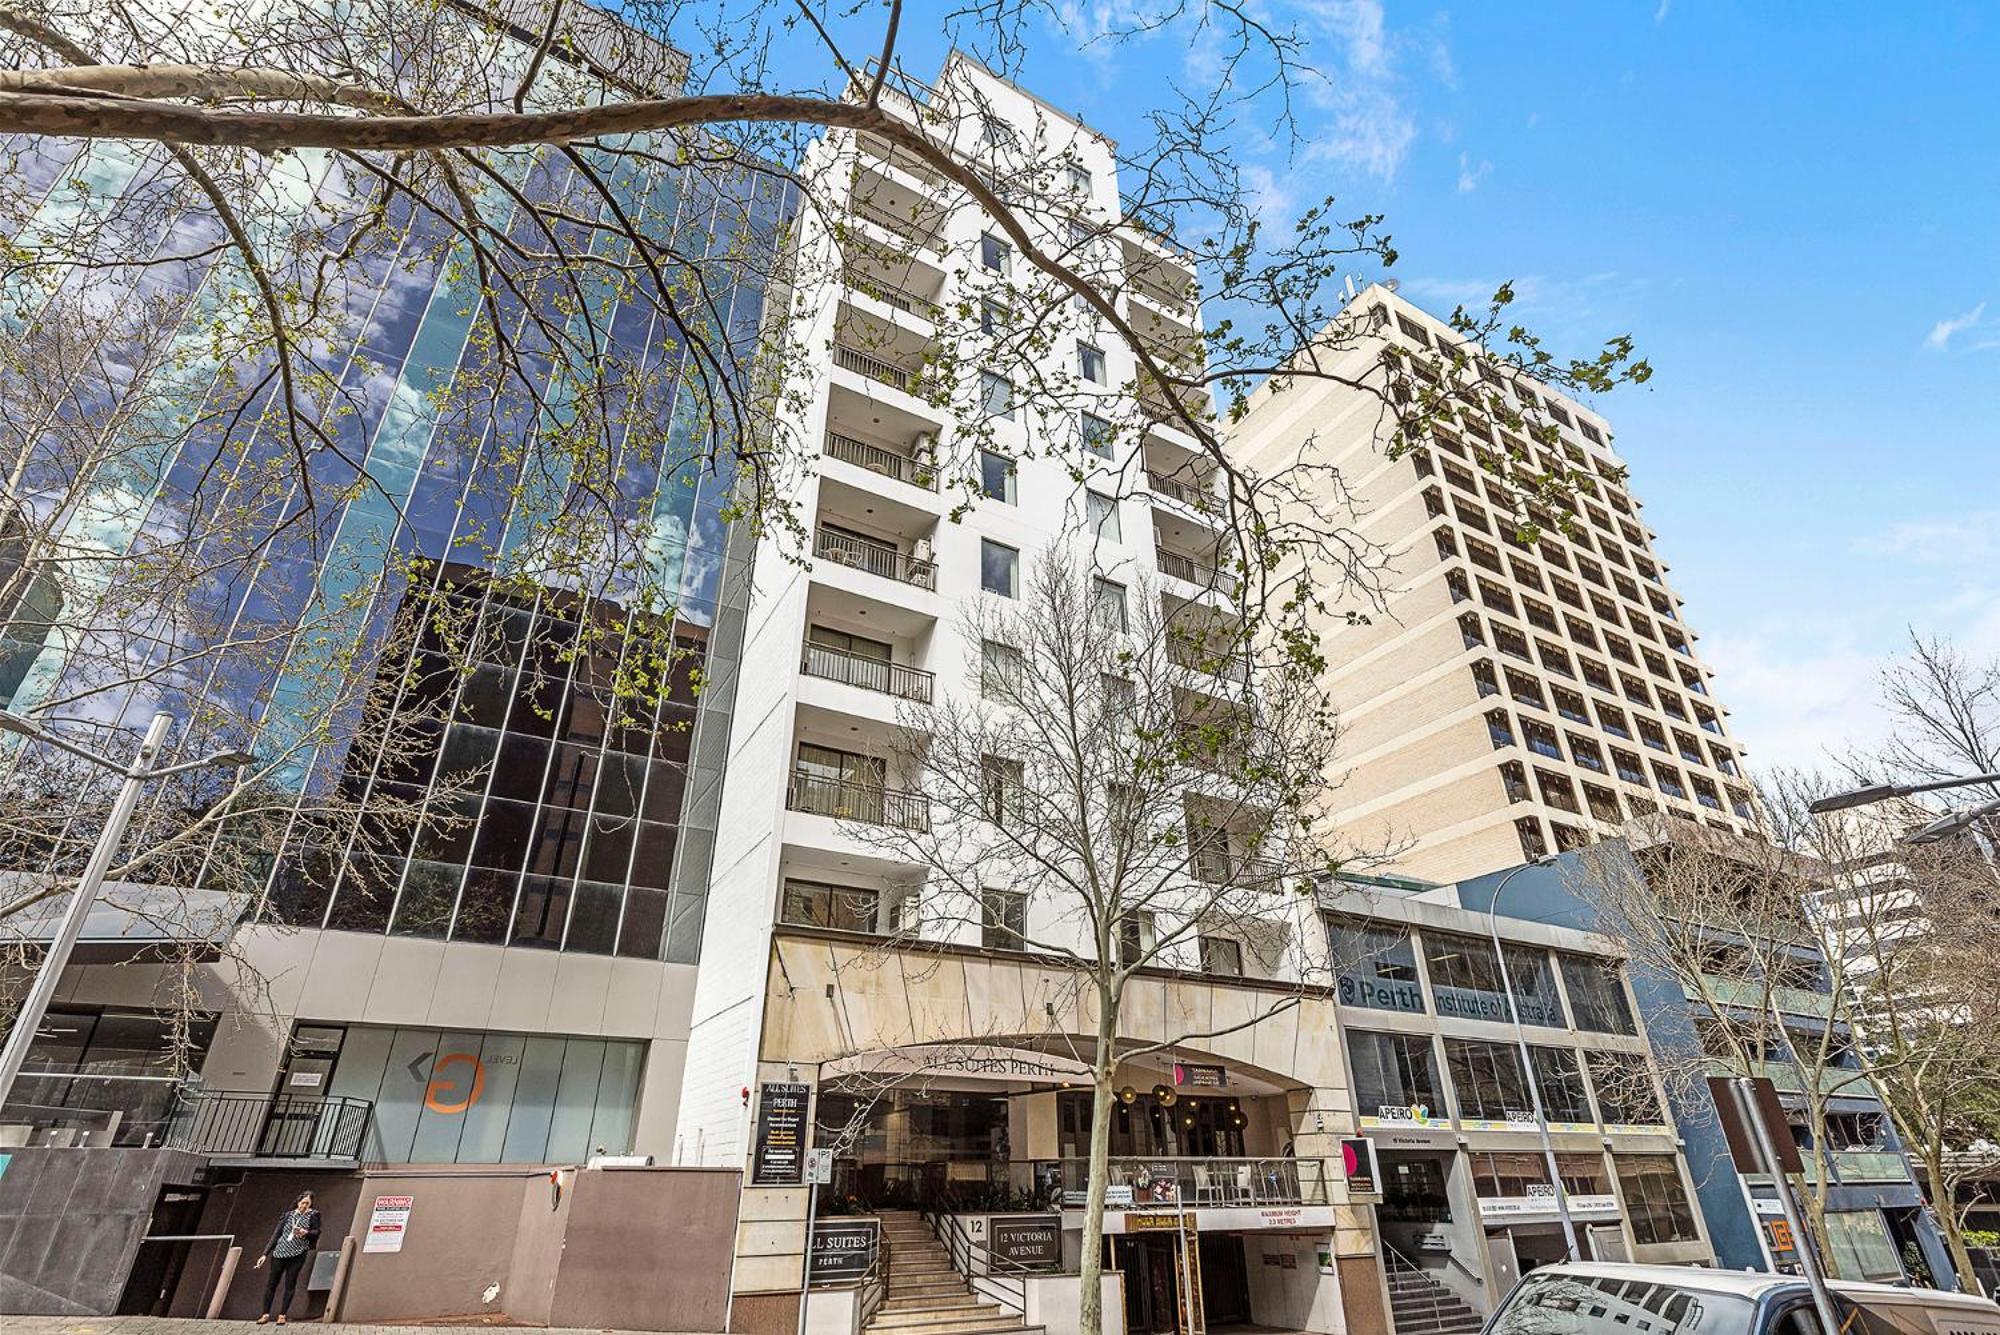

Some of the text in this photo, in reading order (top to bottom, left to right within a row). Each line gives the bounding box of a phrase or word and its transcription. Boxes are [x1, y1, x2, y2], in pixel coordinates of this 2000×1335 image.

[1359, 980, 1422, 1009] Perth
[1436, 992, 1489, 1016] nstitute
[955, 1056, 1006, 1074] SUITES
[1011, 1062, 1054, 1076] PERTH
[1379, 1107, 1413, 1120] APEIRO
[1507, 1111, 1534, 1123] APEIRO
[1527, 1185, 1555, 1197] APEIRO
[970, 1220, 982, 1233] 12
[826, 1236, 867, 1249] SUITES
[1000, 1231, 1053, 1243] 12 VICTORIA
[1008, 1245, 1044, 1256] AVENUE
